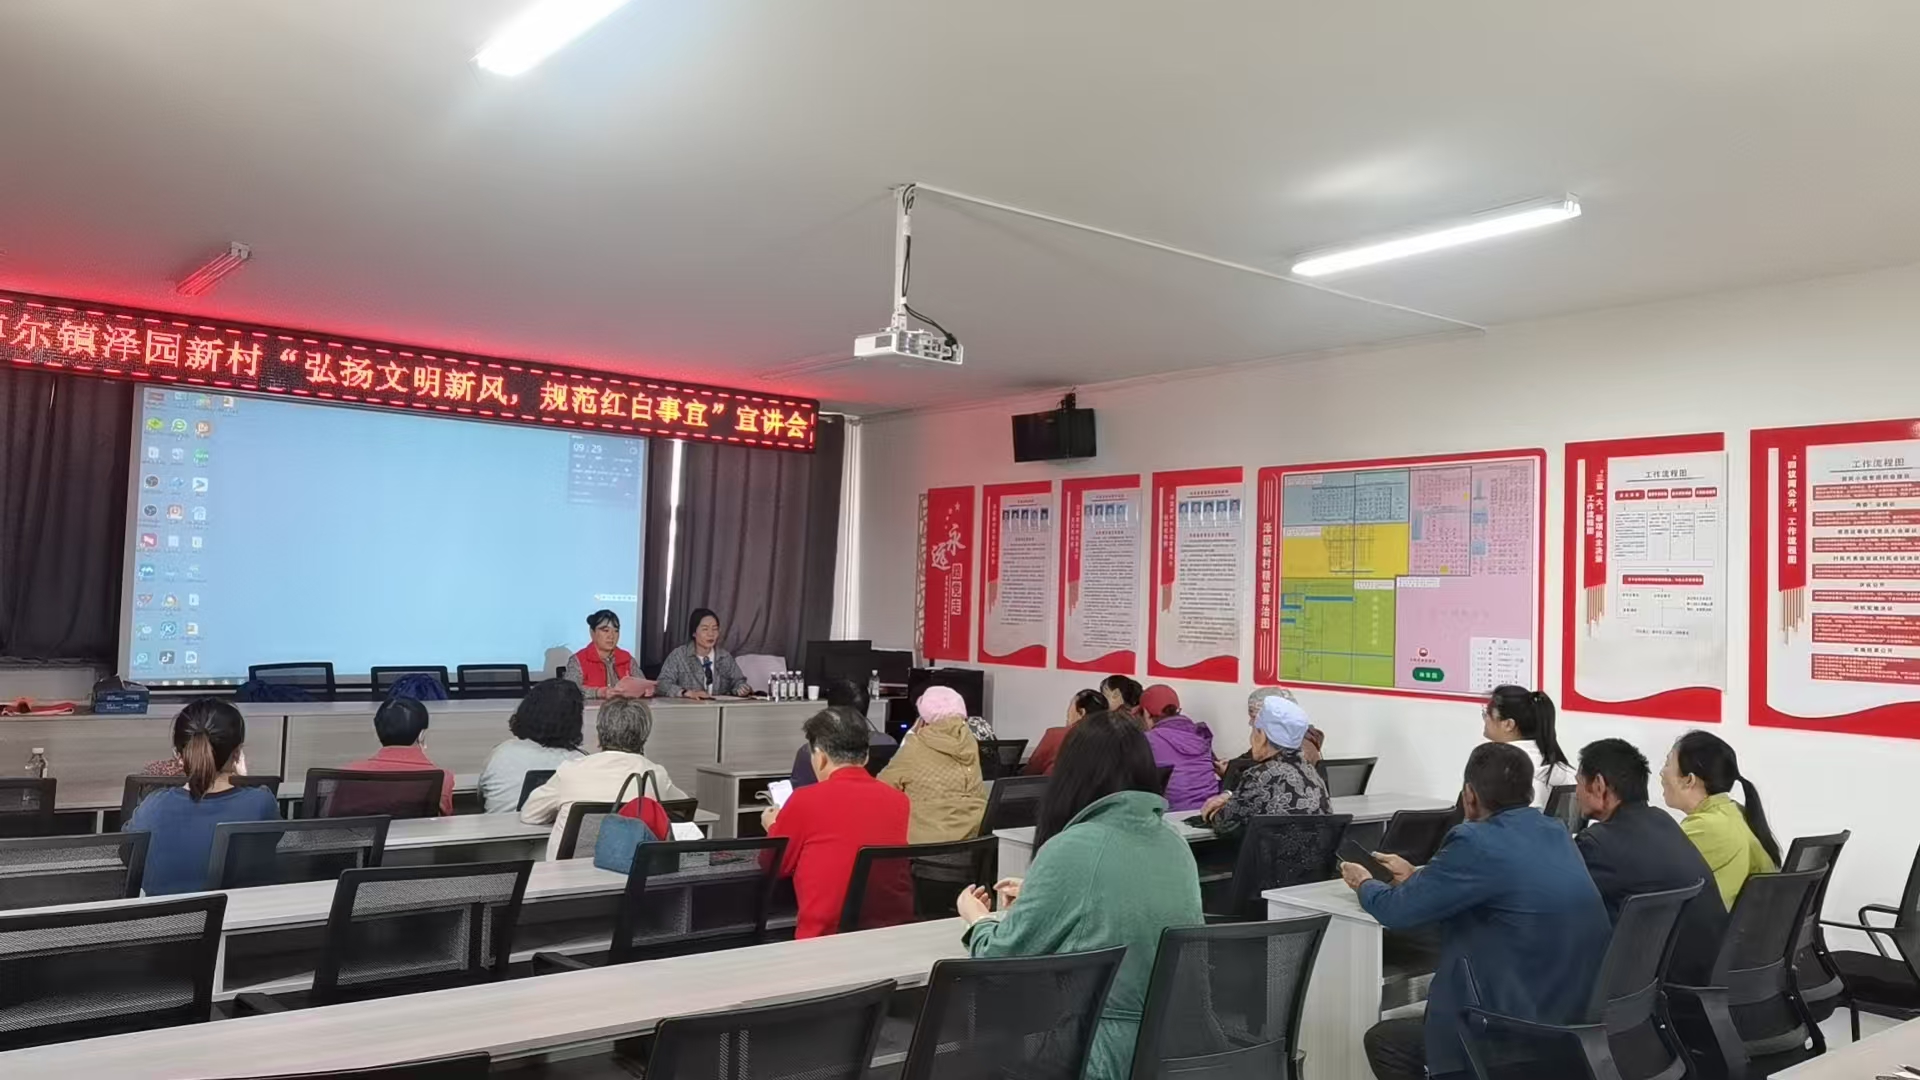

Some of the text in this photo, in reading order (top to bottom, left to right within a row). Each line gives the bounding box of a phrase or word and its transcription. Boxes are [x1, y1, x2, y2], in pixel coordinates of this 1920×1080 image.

[1852, 457, 1905, 468] 工作流程图
[1646, 469, 1688, 479] 工作流程图
